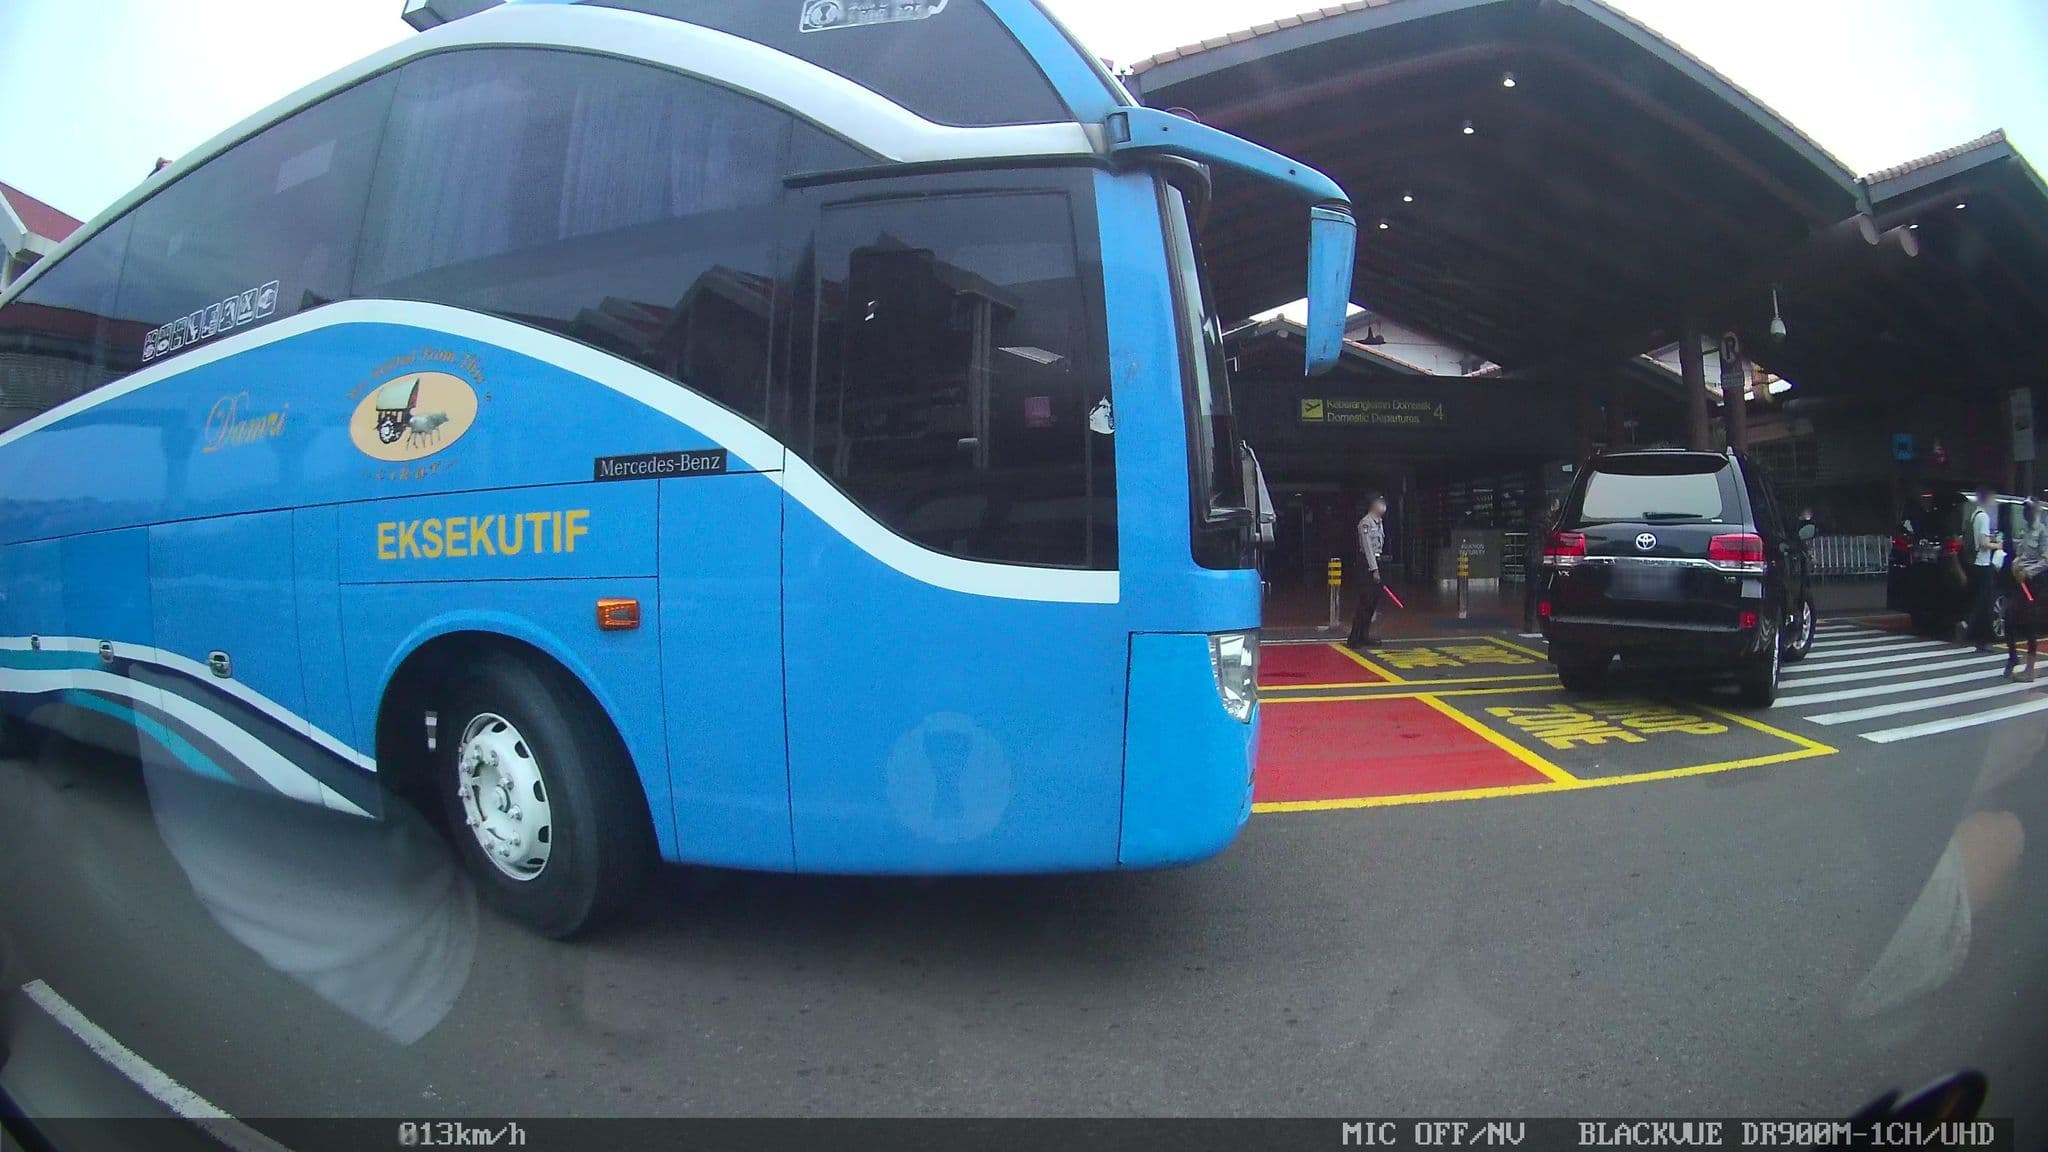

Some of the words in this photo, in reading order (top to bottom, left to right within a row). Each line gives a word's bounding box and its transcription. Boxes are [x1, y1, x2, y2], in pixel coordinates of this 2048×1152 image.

[1327, 412, 1369, 423] Domestic
[1371, 412, 1420, 424] Departures
[1433, 403, 1444, 420] 4
[599, 454, 721, 478] Mercedes-Benz
[377, 508, 591, 561] EKSEKUTIF
[1485, 703, 1647, 750] ZONE
